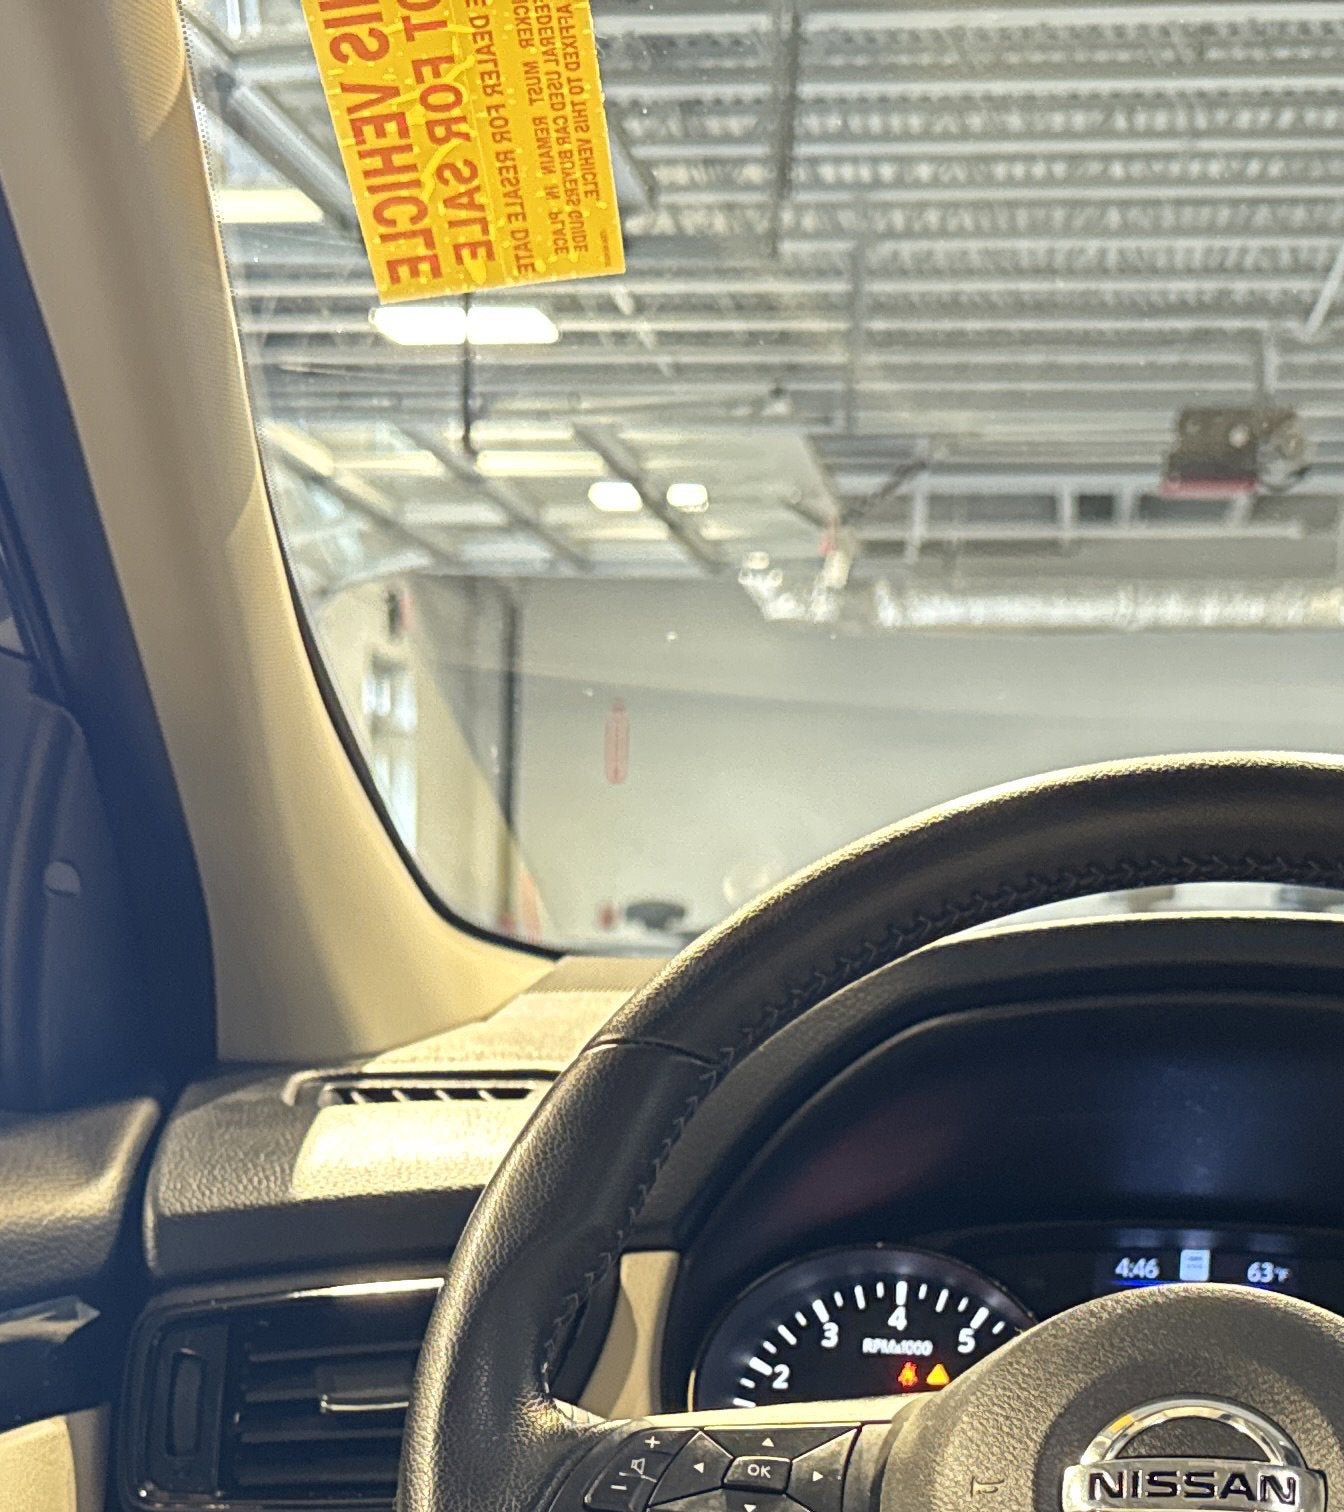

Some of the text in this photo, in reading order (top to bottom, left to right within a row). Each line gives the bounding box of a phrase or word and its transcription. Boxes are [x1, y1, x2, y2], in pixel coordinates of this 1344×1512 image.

[1115, 1257, 1160, 1279] 4:46
[888, 1306, 907, 1331] 4
[821, 1322, 839, 1348] 3
[958, 1327, 975, 1354] 5
[773, 1364, 790, 1389] 2
[747, 1464, 771, 1478] OK
[1089, 1470, 1297, 1506] NISSAN
